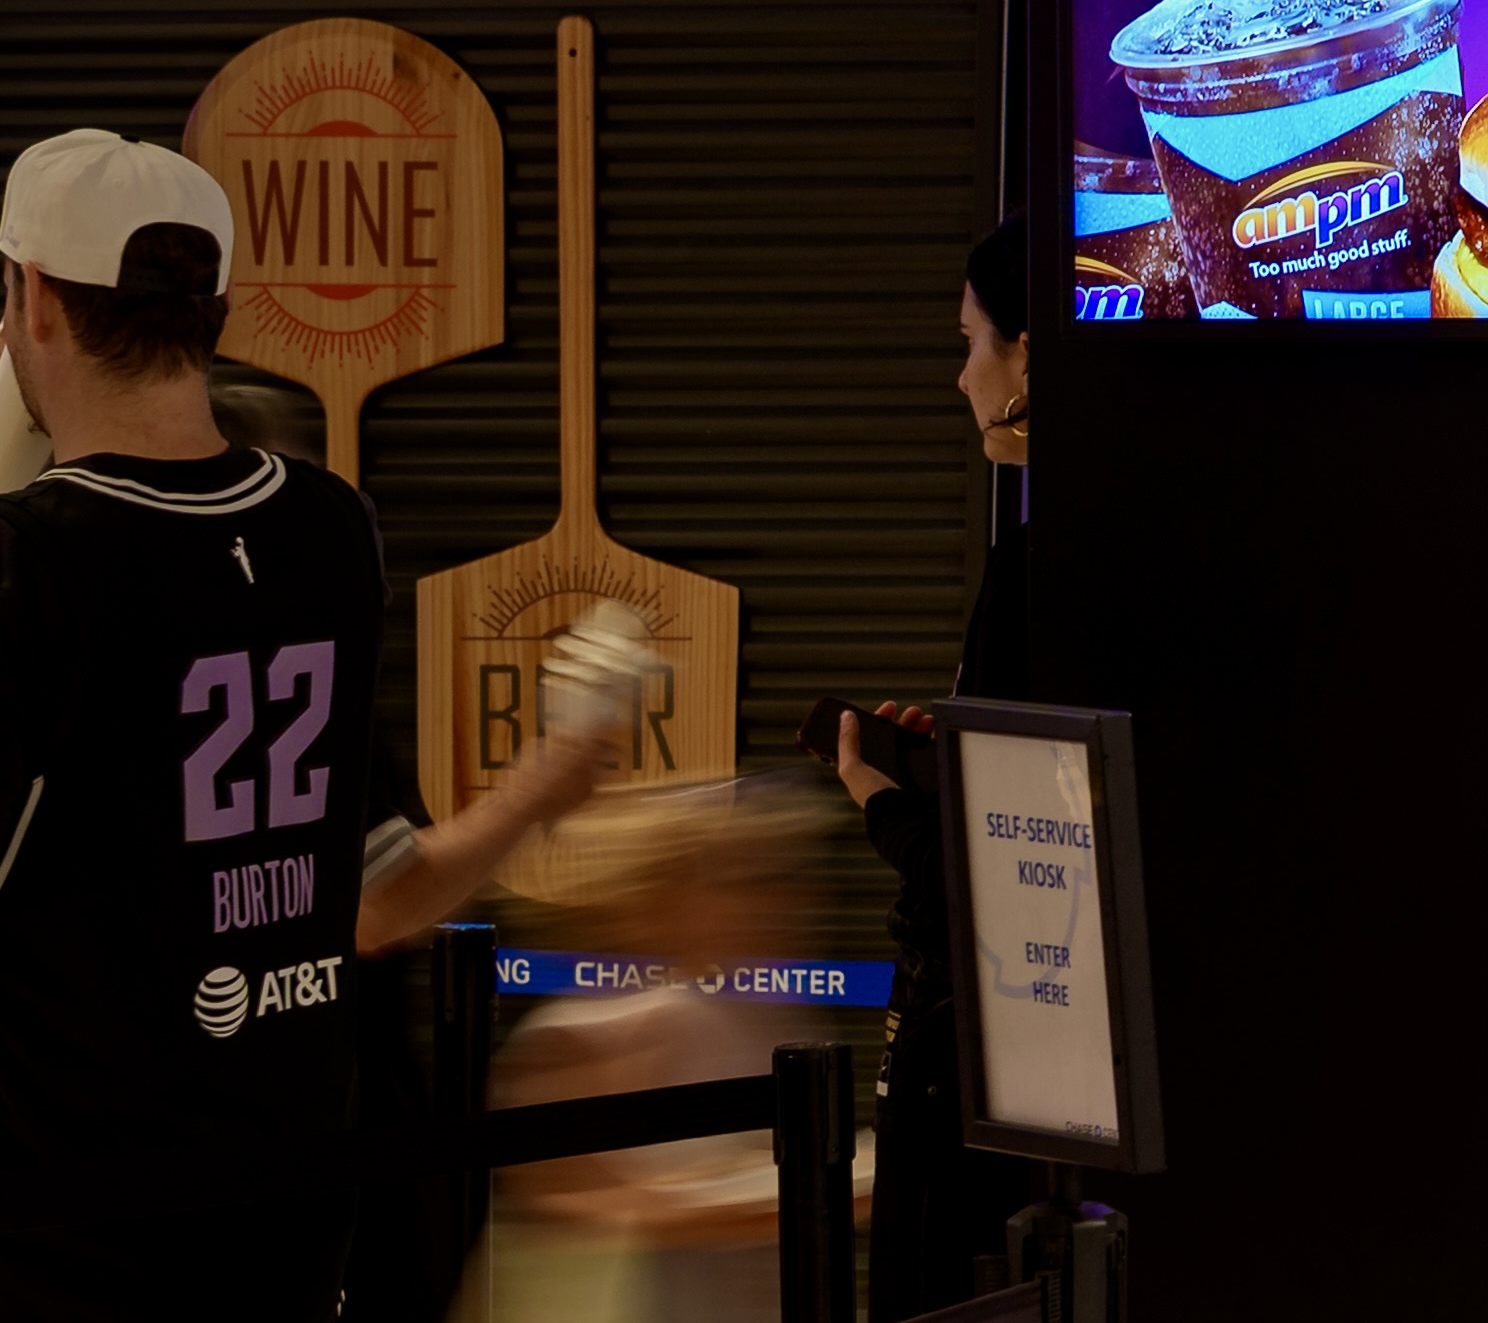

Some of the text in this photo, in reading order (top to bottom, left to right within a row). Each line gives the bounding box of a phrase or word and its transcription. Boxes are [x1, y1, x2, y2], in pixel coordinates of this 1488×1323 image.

[242, 160, 438, 267] WINE
[1233, 171, 1408, 248] ampm
[1249, 261, 1280, 278] Too
[1283, 251, 1325, 273] much
[1328, 240, 1370, 270] good
[180, 640, 336, 843] 22
[480, 664, 676, 770] BER
[987, 813, 1091, 848] SELF-SERVICE
[212, 853, 315, 934] BURTON
[1018, 860, 1067, 889] KIOSK
[1026, 942, 1071, 968] ENTER
[256, 956, 343, 1018] AT&T
[733, 966, 846, 996] CENTER
[1033, 981, 1069, 1007] HERE
